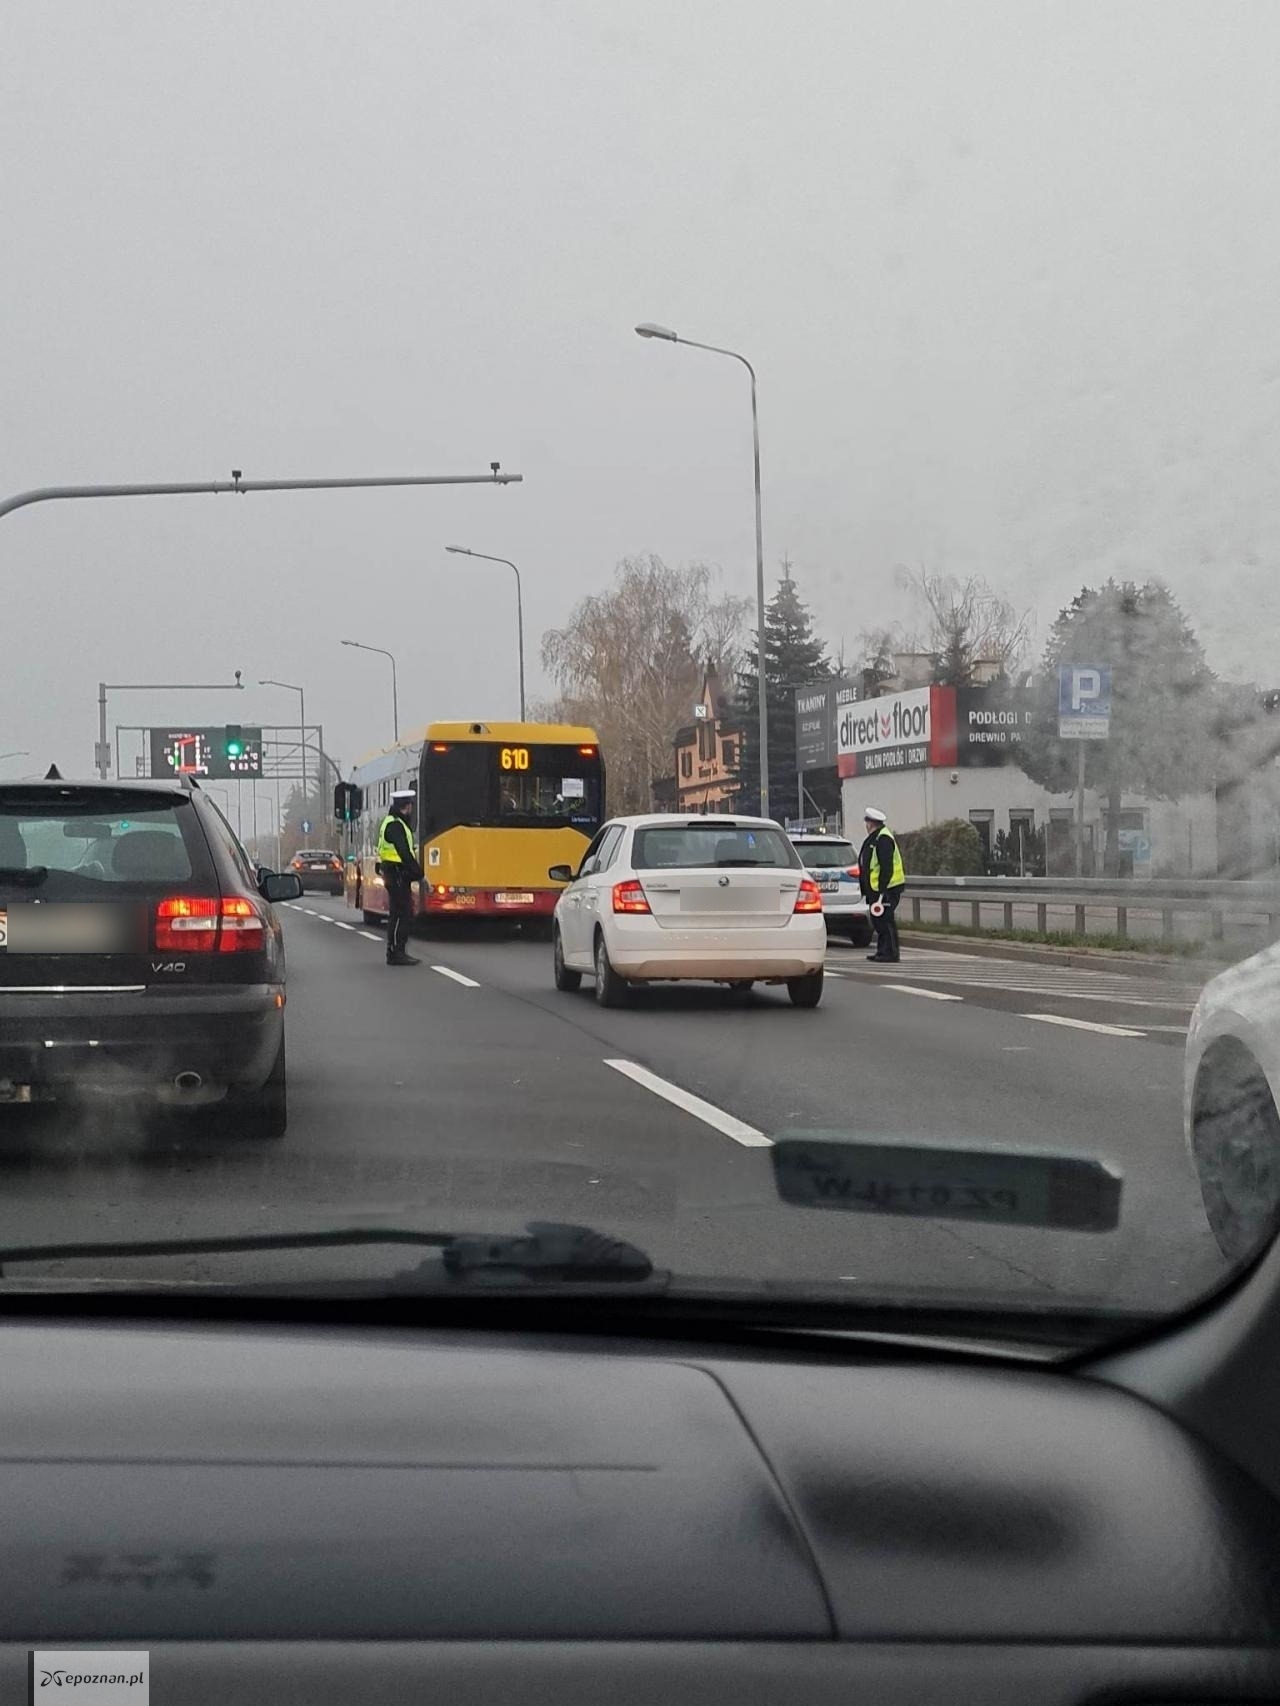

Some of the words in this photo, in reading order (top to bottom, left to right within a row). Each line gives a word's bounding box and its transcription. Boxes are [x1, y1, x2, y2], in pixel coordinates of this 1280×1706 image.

[836, 687, 857, 704] MEBLE
[840, 711, 879, 747] direct
[893, 702, 928, 739] floor
[968, 711, 1018, 725] PODŁOGI
[969, 732, 1006, 743] DREWNO
[501, 748, 529, 770] 610
[865, 753, 882, 769] SALON
[152, 962, 186, 973] V40
